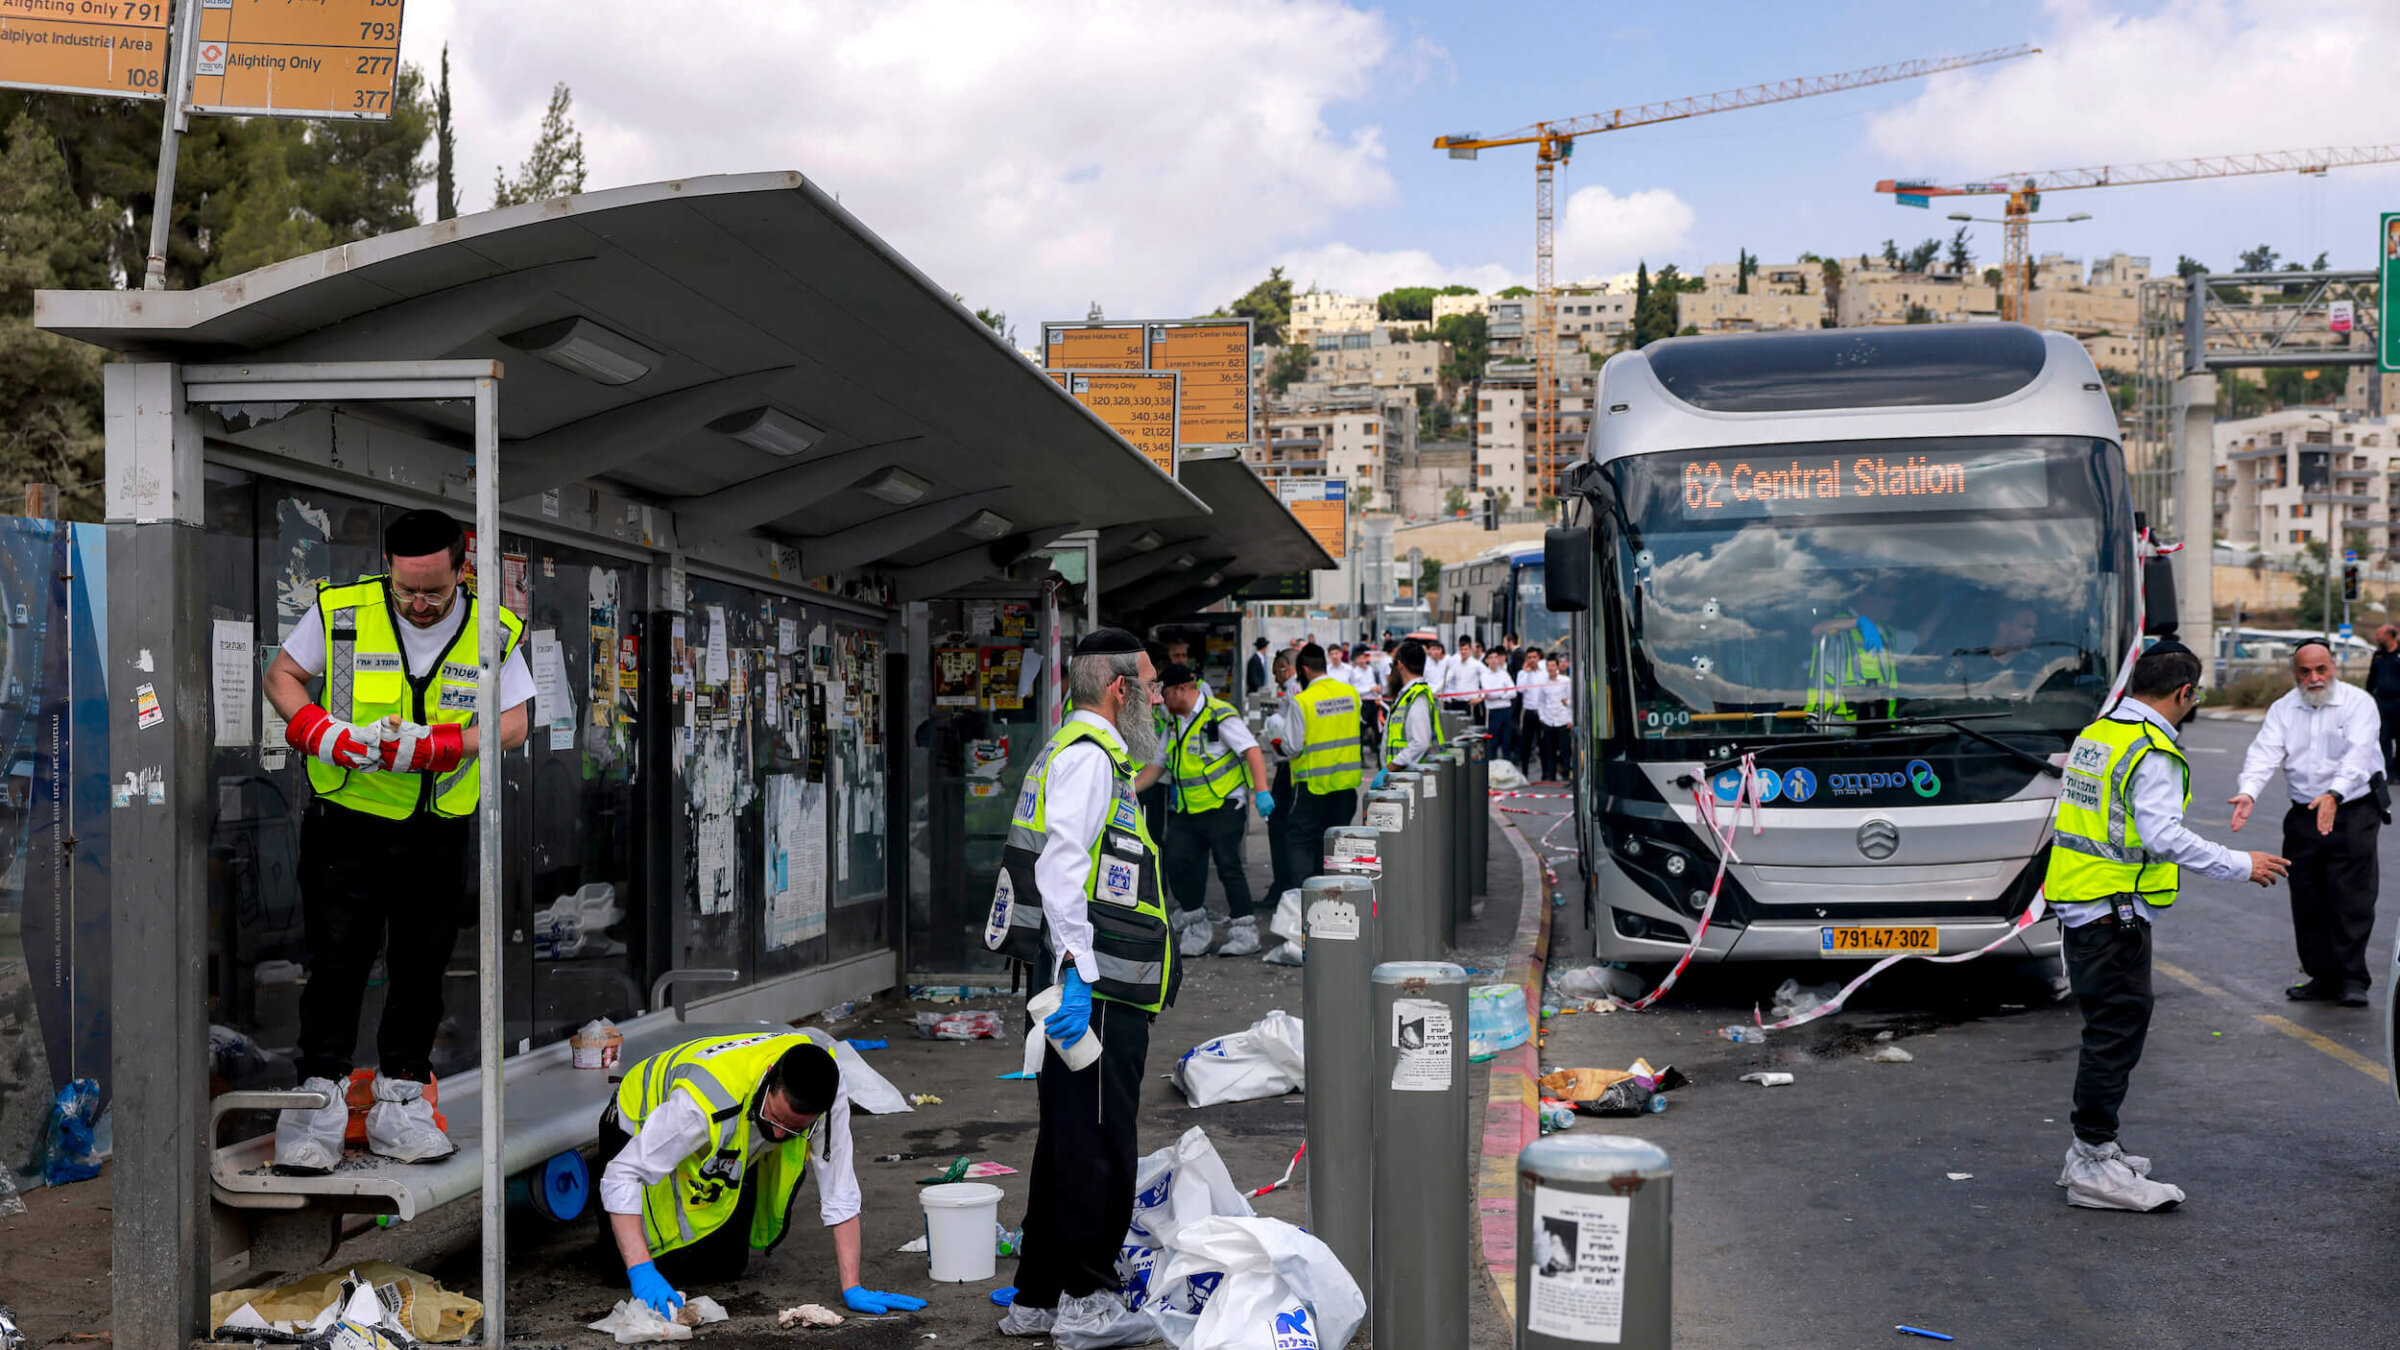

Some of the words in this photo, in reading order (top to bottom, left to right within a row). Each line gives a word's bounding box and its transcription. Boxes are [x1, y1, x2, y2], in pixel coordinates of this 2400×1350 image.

[81, 1, 118, 18] Only
[124, 3, 160, 22] 791
[0, 29, 48, 45] alpiyot
[52, 32, 116, 49] Industrial
[119, 38, 153, 51] Area
[360, 22, 395, 41] 793
[228, 53, 286, 71] Alighting
[289, 56, 322, 73] Only
[356, 56, 393, 76] 277
[127, 68, 159, 88] 108
[353, 90, 390, 109] 377
[1120, 382, 1137, 390] Only
[1133, 443, 1170, 453] 45,345
[1685, 461, 1723, 509] 62
[1730, 459, 1841, 502] Central
[1853, 456, 1965, 498] Station
[442, 665, 479, 680] שטרה
[1828, 772, 1906, 789] סופרבוס
[1278, 1337, 1317, 1349] הצלה
